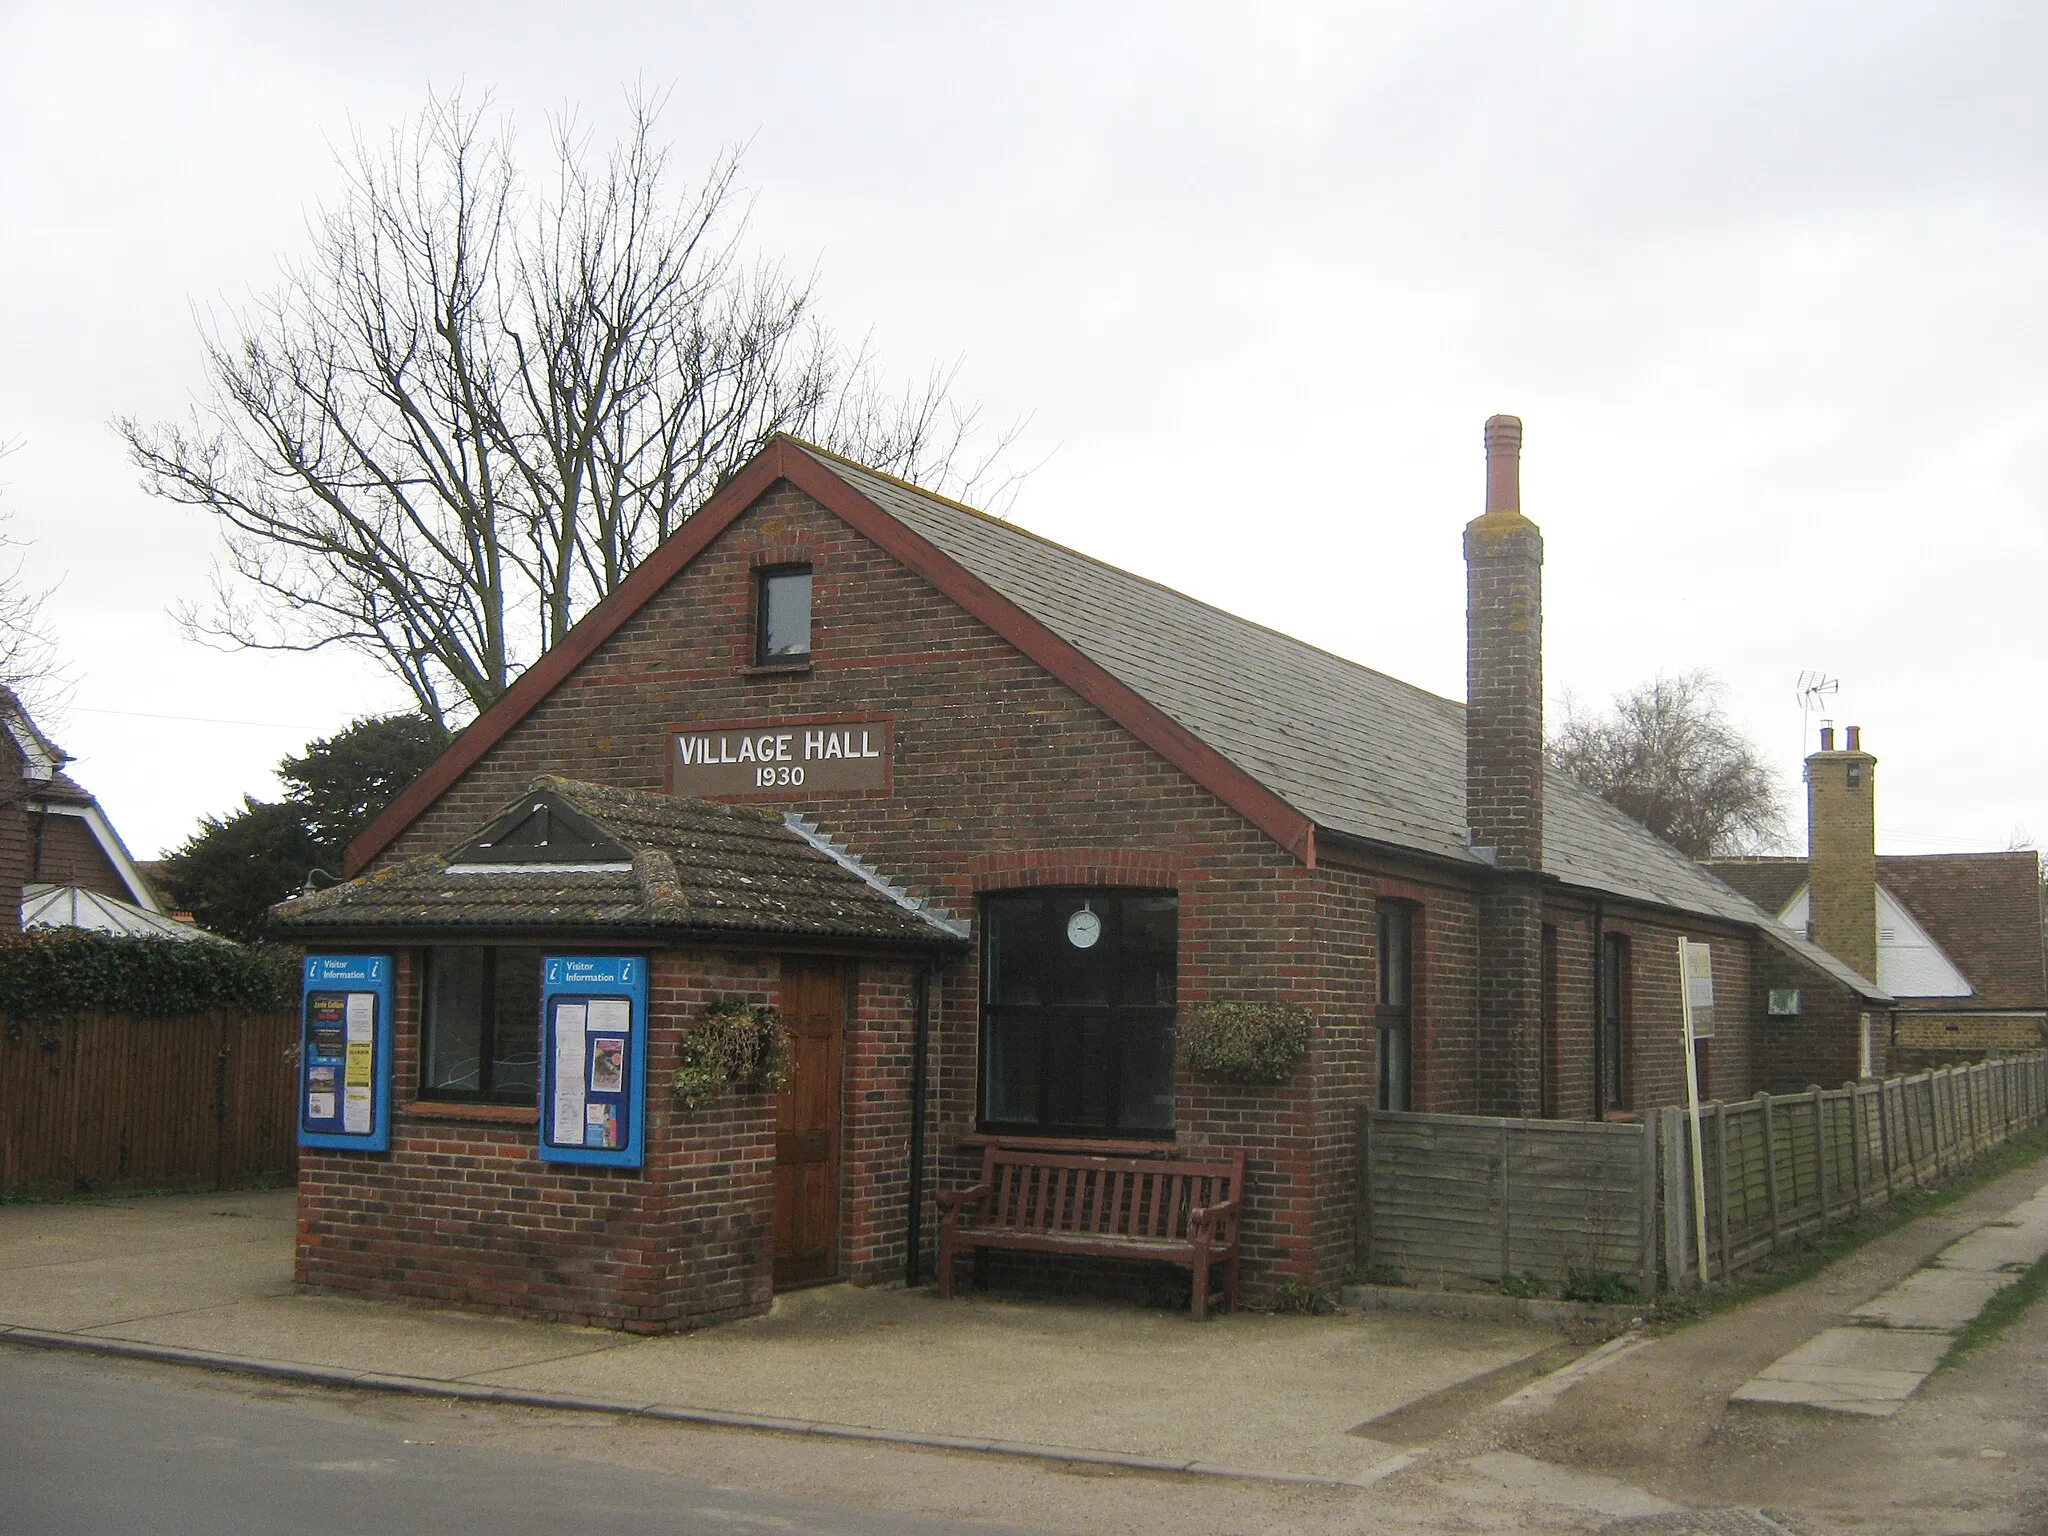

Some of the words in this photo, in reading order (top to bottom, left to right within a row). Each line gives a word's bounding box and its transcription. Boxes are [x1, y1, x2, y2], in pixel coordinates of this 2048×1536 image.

[679, 734, 793, 765] VILLAGE
[804, 730, 880, 760] HALL
[756, 766, 806, 787] 1930
[324, 960, 347, 969] Visitor
[566, 961, 594, 971] Visitor
[323, 970, 365, 979] Information
[565, 972, 614, 982] Information
